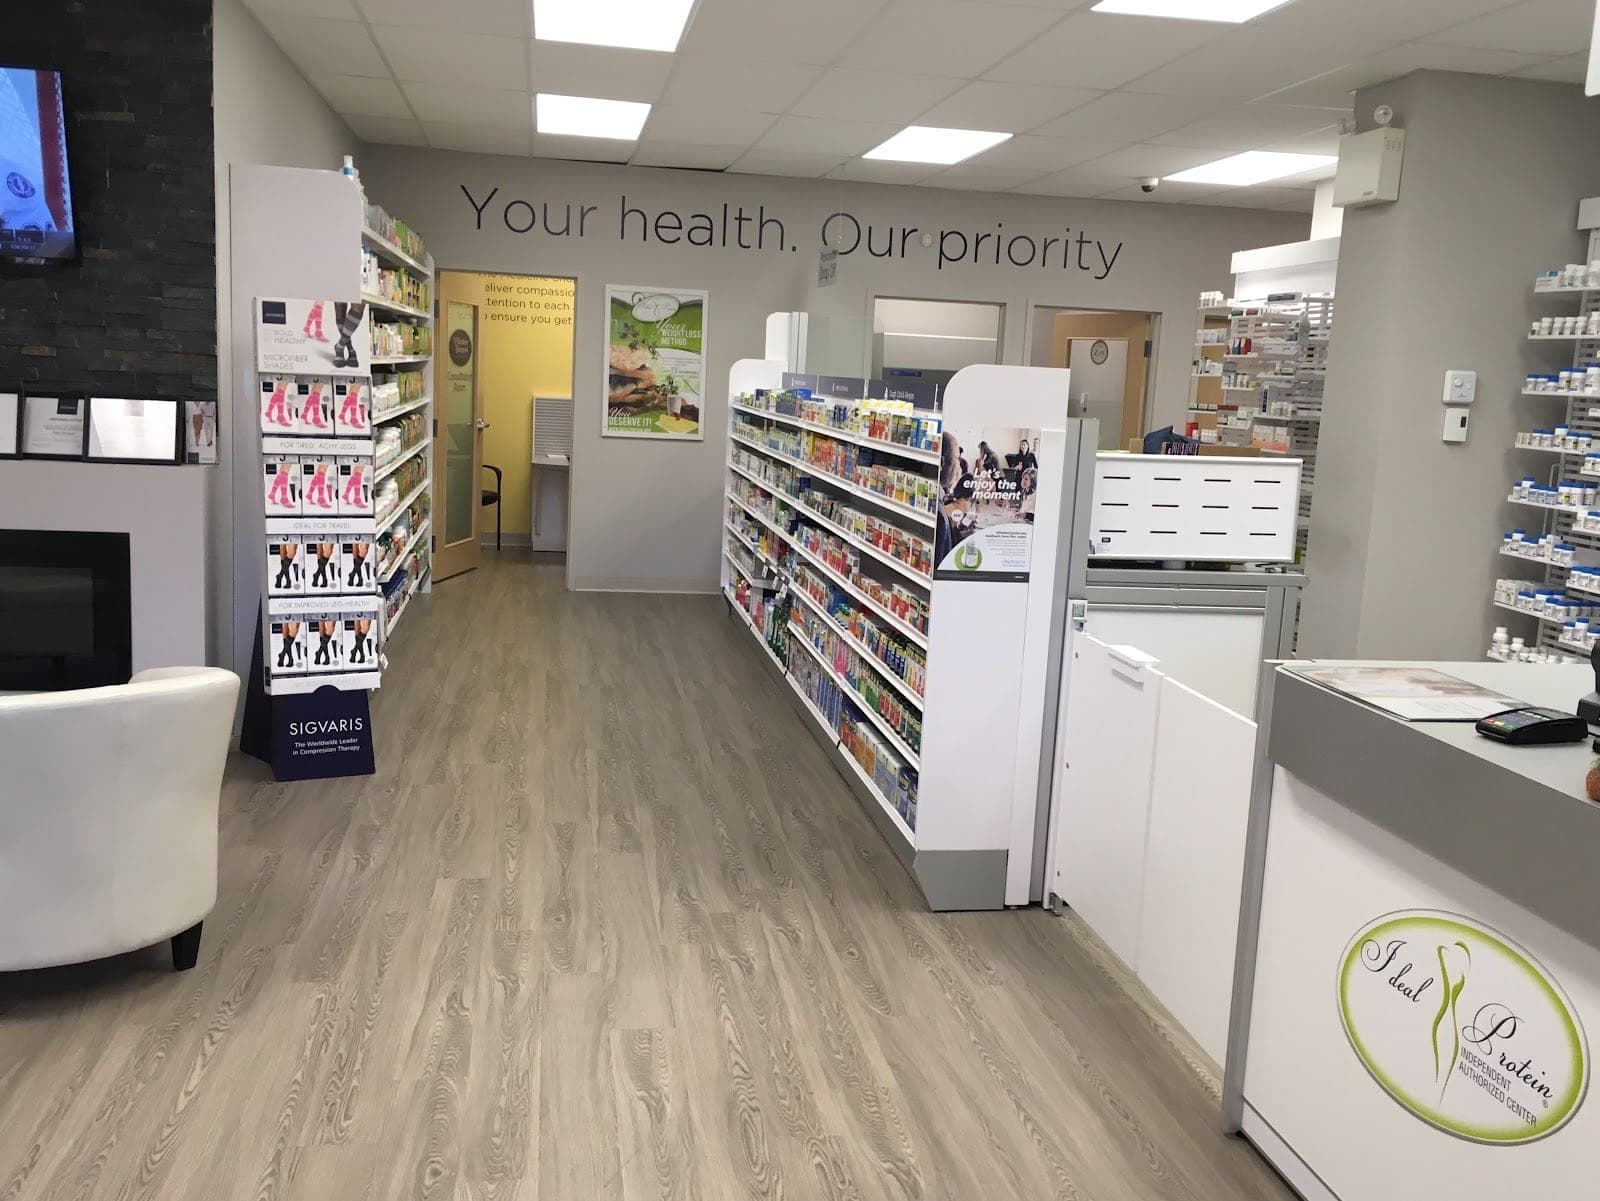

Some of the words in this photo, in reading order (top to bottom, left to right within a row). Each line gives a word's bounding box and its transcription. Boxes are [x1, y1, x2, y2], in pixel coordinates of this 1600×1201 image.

[460, 184, 598, 237] Your
[620, 195, 797, 252] health.
[821, 212, 918, 258] Our
[938, 223, 1123, 279] priority
[529, 298, 541, 309] to
[544, 300, 570, 311] each
[490, 312, 527, 323] ensure
[530, 315, 551, 325] you
[554, 316, 572, 326] get
[608, 417, 642, 426] DESERVE
[974, 468, 1000, 479] Let's
[963, 479, 995, 492] enjoy
[998, 479, 1017, 490] the
[972, 490, 1022, 500] moment
[279, 601, 292, 609] FOR
[295, 600, 329, 608] IMPROVED
[330, 600, 344, 608] LEG
[345, 599, 369, 607] HEALTH
[289, 717, 363, 736] SIGVARIS
[306, 739, 338, 747] Worldwide
[299, 747, 337, 756] Compression
[1360, 939, 1434, 1003] Ideal
[1460, 1046, 1512, 1092] INDEPENDENT
[1458, 1061, 1506, 1104] AUTHORIZED
[1506, 1097, 1538, 1128] CENTER
